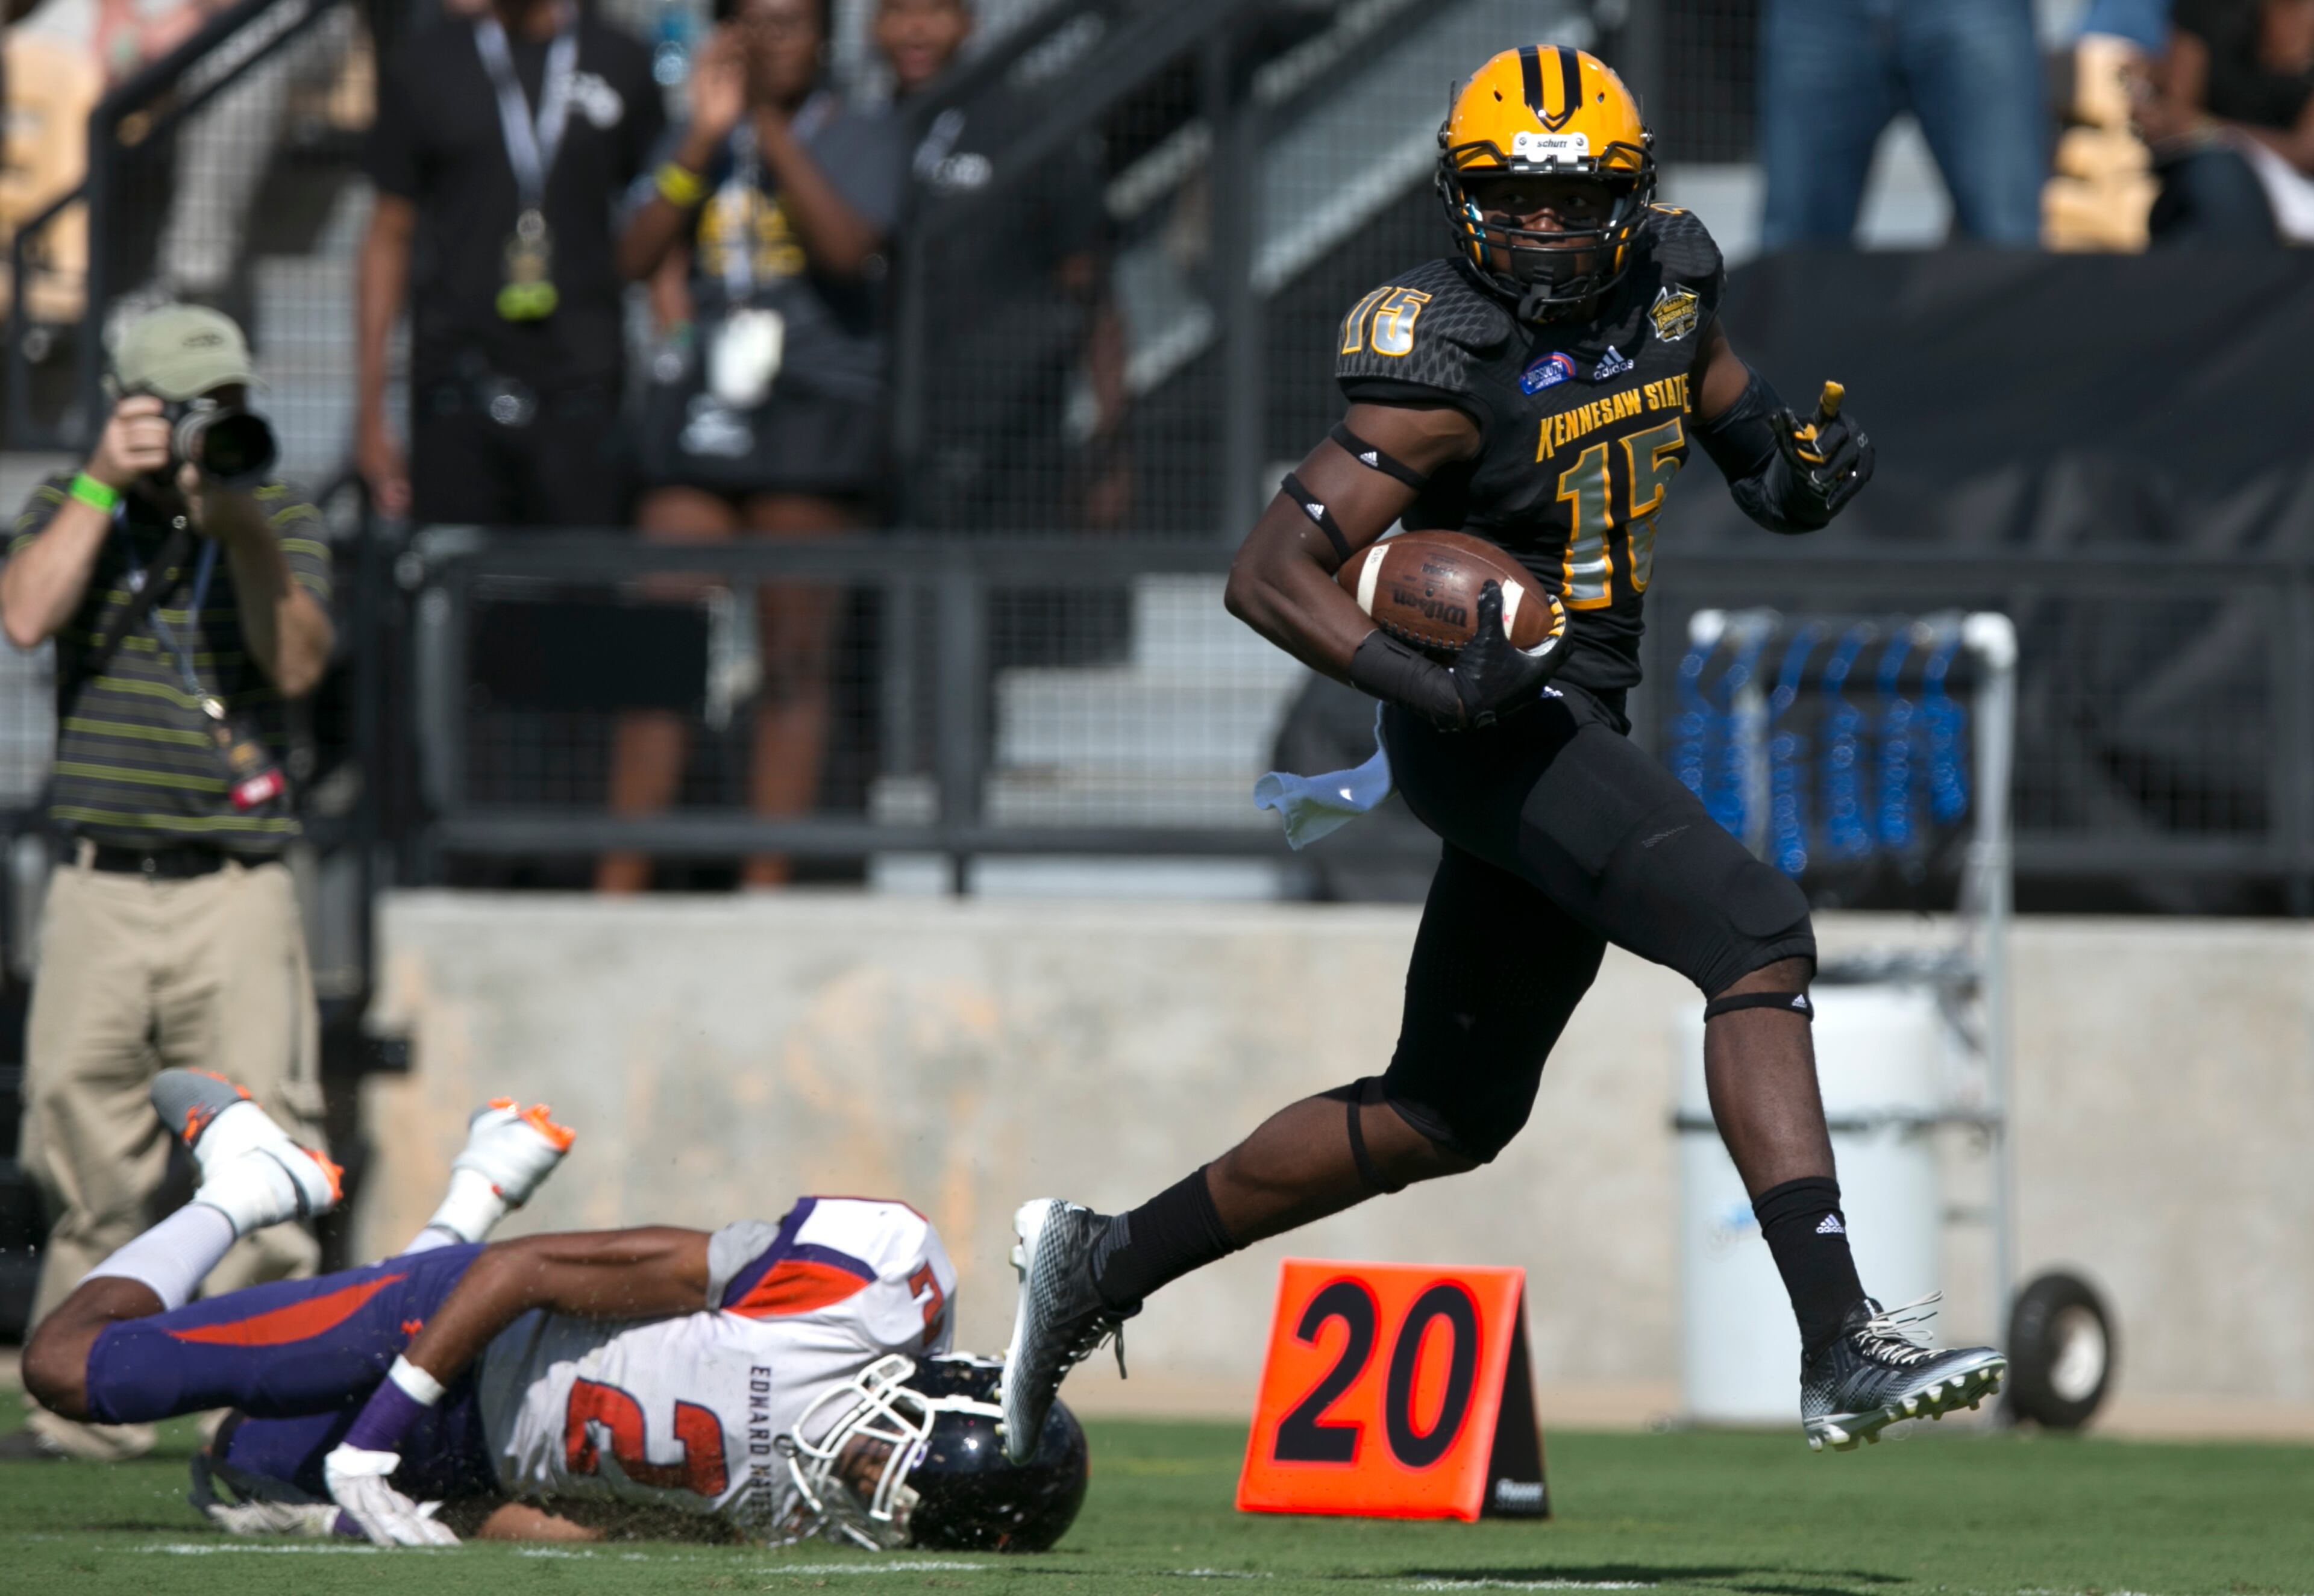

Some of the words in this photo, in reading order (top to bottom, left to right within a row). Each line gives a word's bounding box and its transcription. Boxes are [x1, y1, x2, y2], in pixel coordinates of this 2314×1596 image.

[1537, 139, 1567, 148] schutt
[1341, 286, 1433, 357] 15
[1593, 359, 1634, 381] adidas
[1535, 389, 1642, 463] KENNESAW
[1643, 373, 1692, 413] STATE
[1556, 416, 1685, 610] 15
[1391, 587, 1468, 628] Wilson
[749, 1365, 771, 1455] EDWARD
[1271, 1278, 1481, 1469] 20
[565, 1377, 730, 1499] 2
